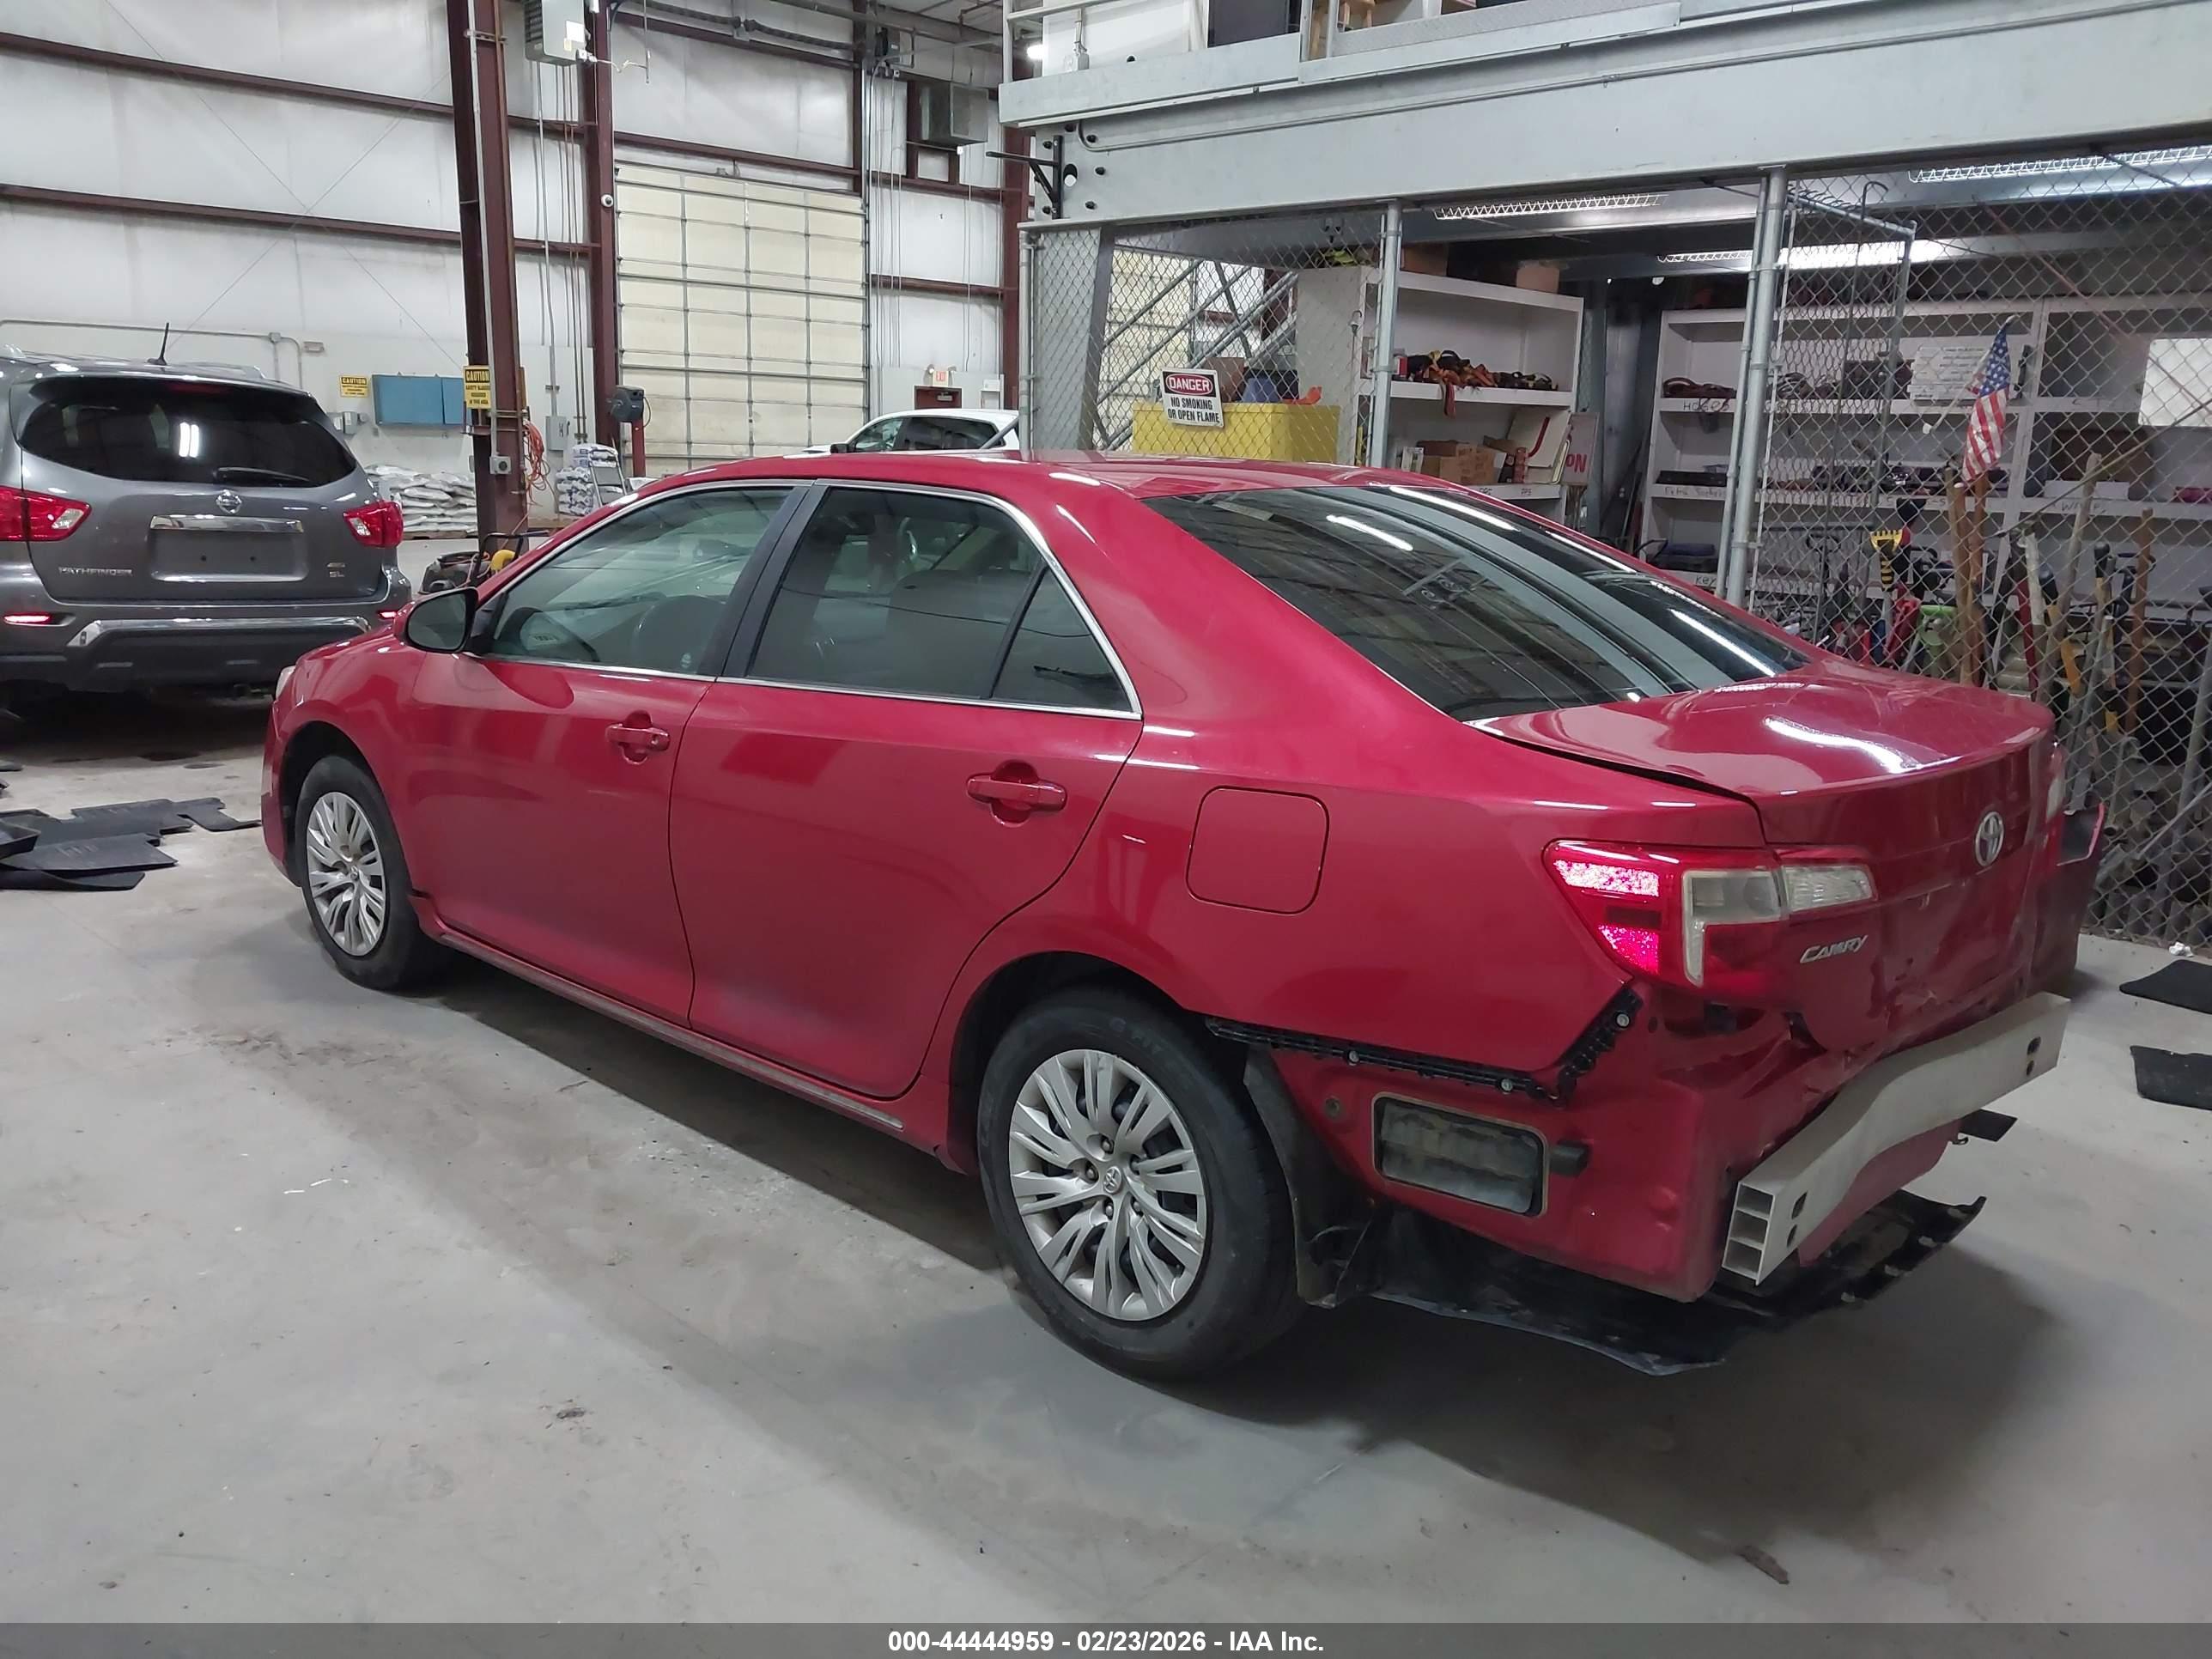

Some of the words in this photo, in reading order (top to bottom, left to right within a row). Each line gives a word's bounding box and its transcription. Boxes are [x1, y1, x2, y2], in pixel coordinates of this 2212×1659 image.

[466, 370, 489, 382] CAUTION
[1169, 377, 1210, 392] DANGER
[1170, 397, 1181, 408] NO
[1182, 398, 1213, 410] SMOKING
[1168, 409, 1177, 419] OR
[1178, 410, 1195, 421] OPEN
[1197, 411, 1220, 423] FLAME
[58, 567, 132, 577] PATHFINDER
[1800, 934, 1869, 963] CAMRY
